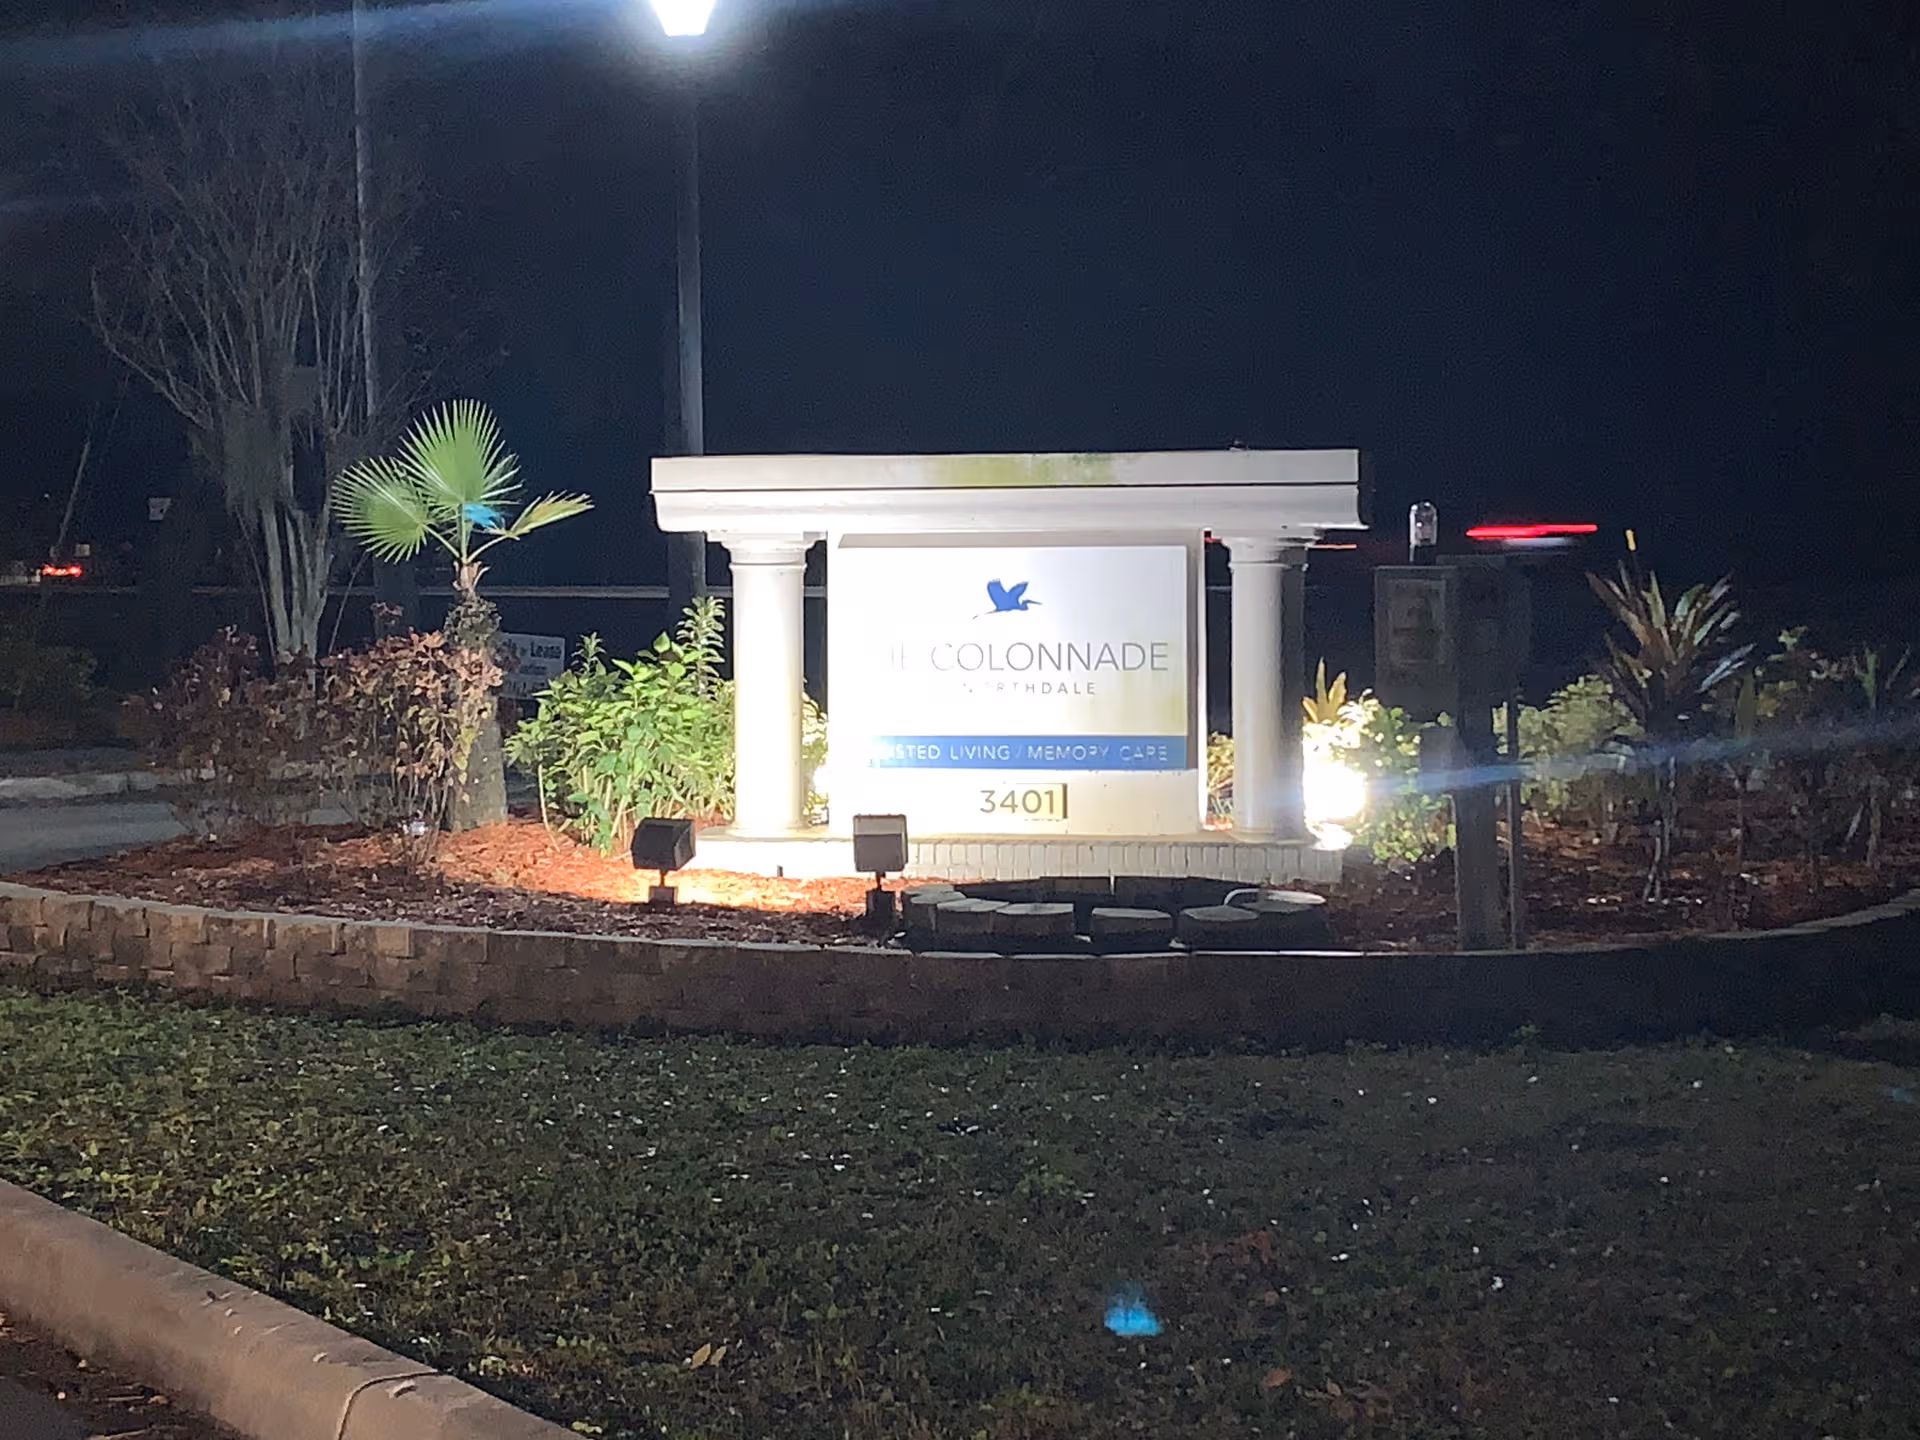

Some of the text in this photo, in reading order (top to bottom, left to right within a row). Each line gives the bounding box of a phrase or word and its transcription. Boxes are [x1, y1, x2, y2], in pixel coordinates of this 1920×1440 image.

[931, 642, 1169, 672] COLONNADE
[949, 744, 1011, 761] LIVING
[979, 789, 1054, 815] 3401
